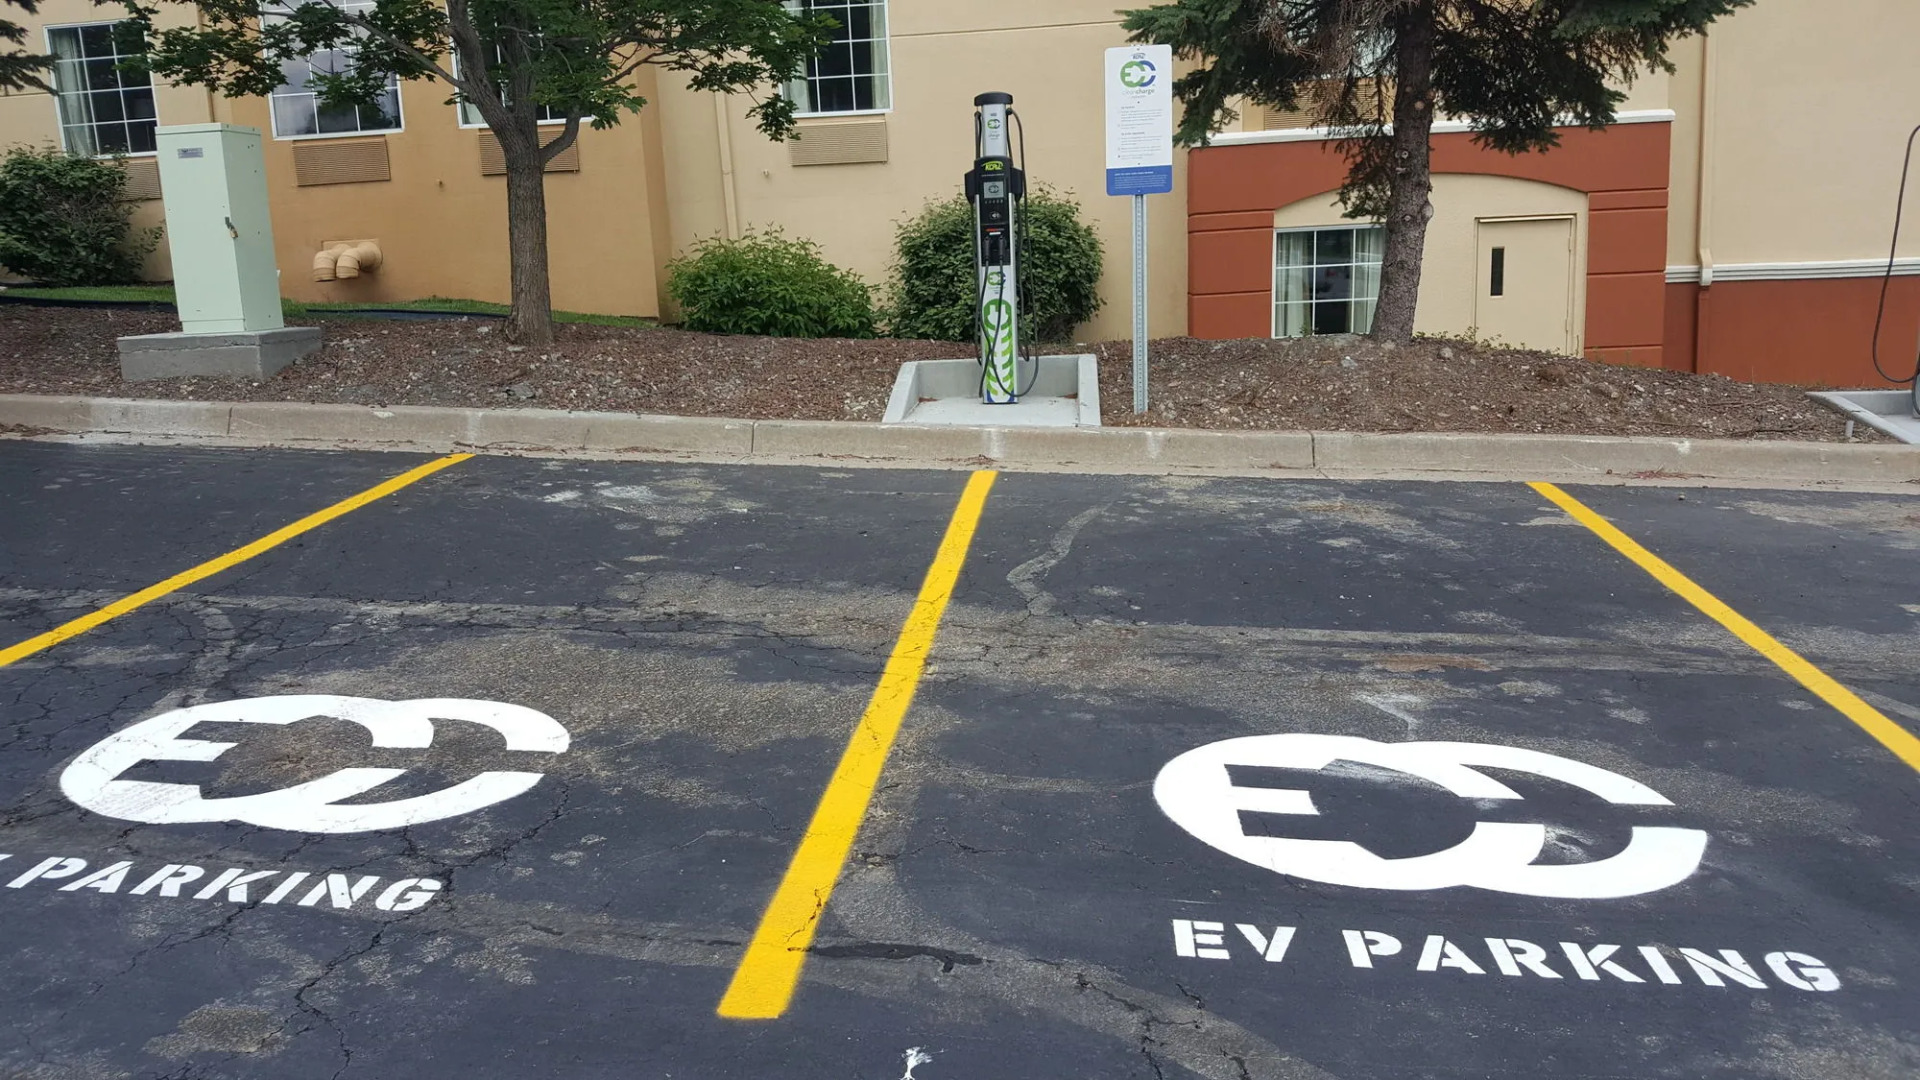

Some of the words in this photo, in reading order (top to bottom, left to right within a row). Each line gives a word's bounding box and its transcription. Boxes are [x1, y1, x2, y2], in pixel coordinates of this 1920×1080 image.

[6, 856, 443, 912] PARKING
[1172, 919, 1298, 963] EV
[1341, 929, 1842, 992] PARKING
